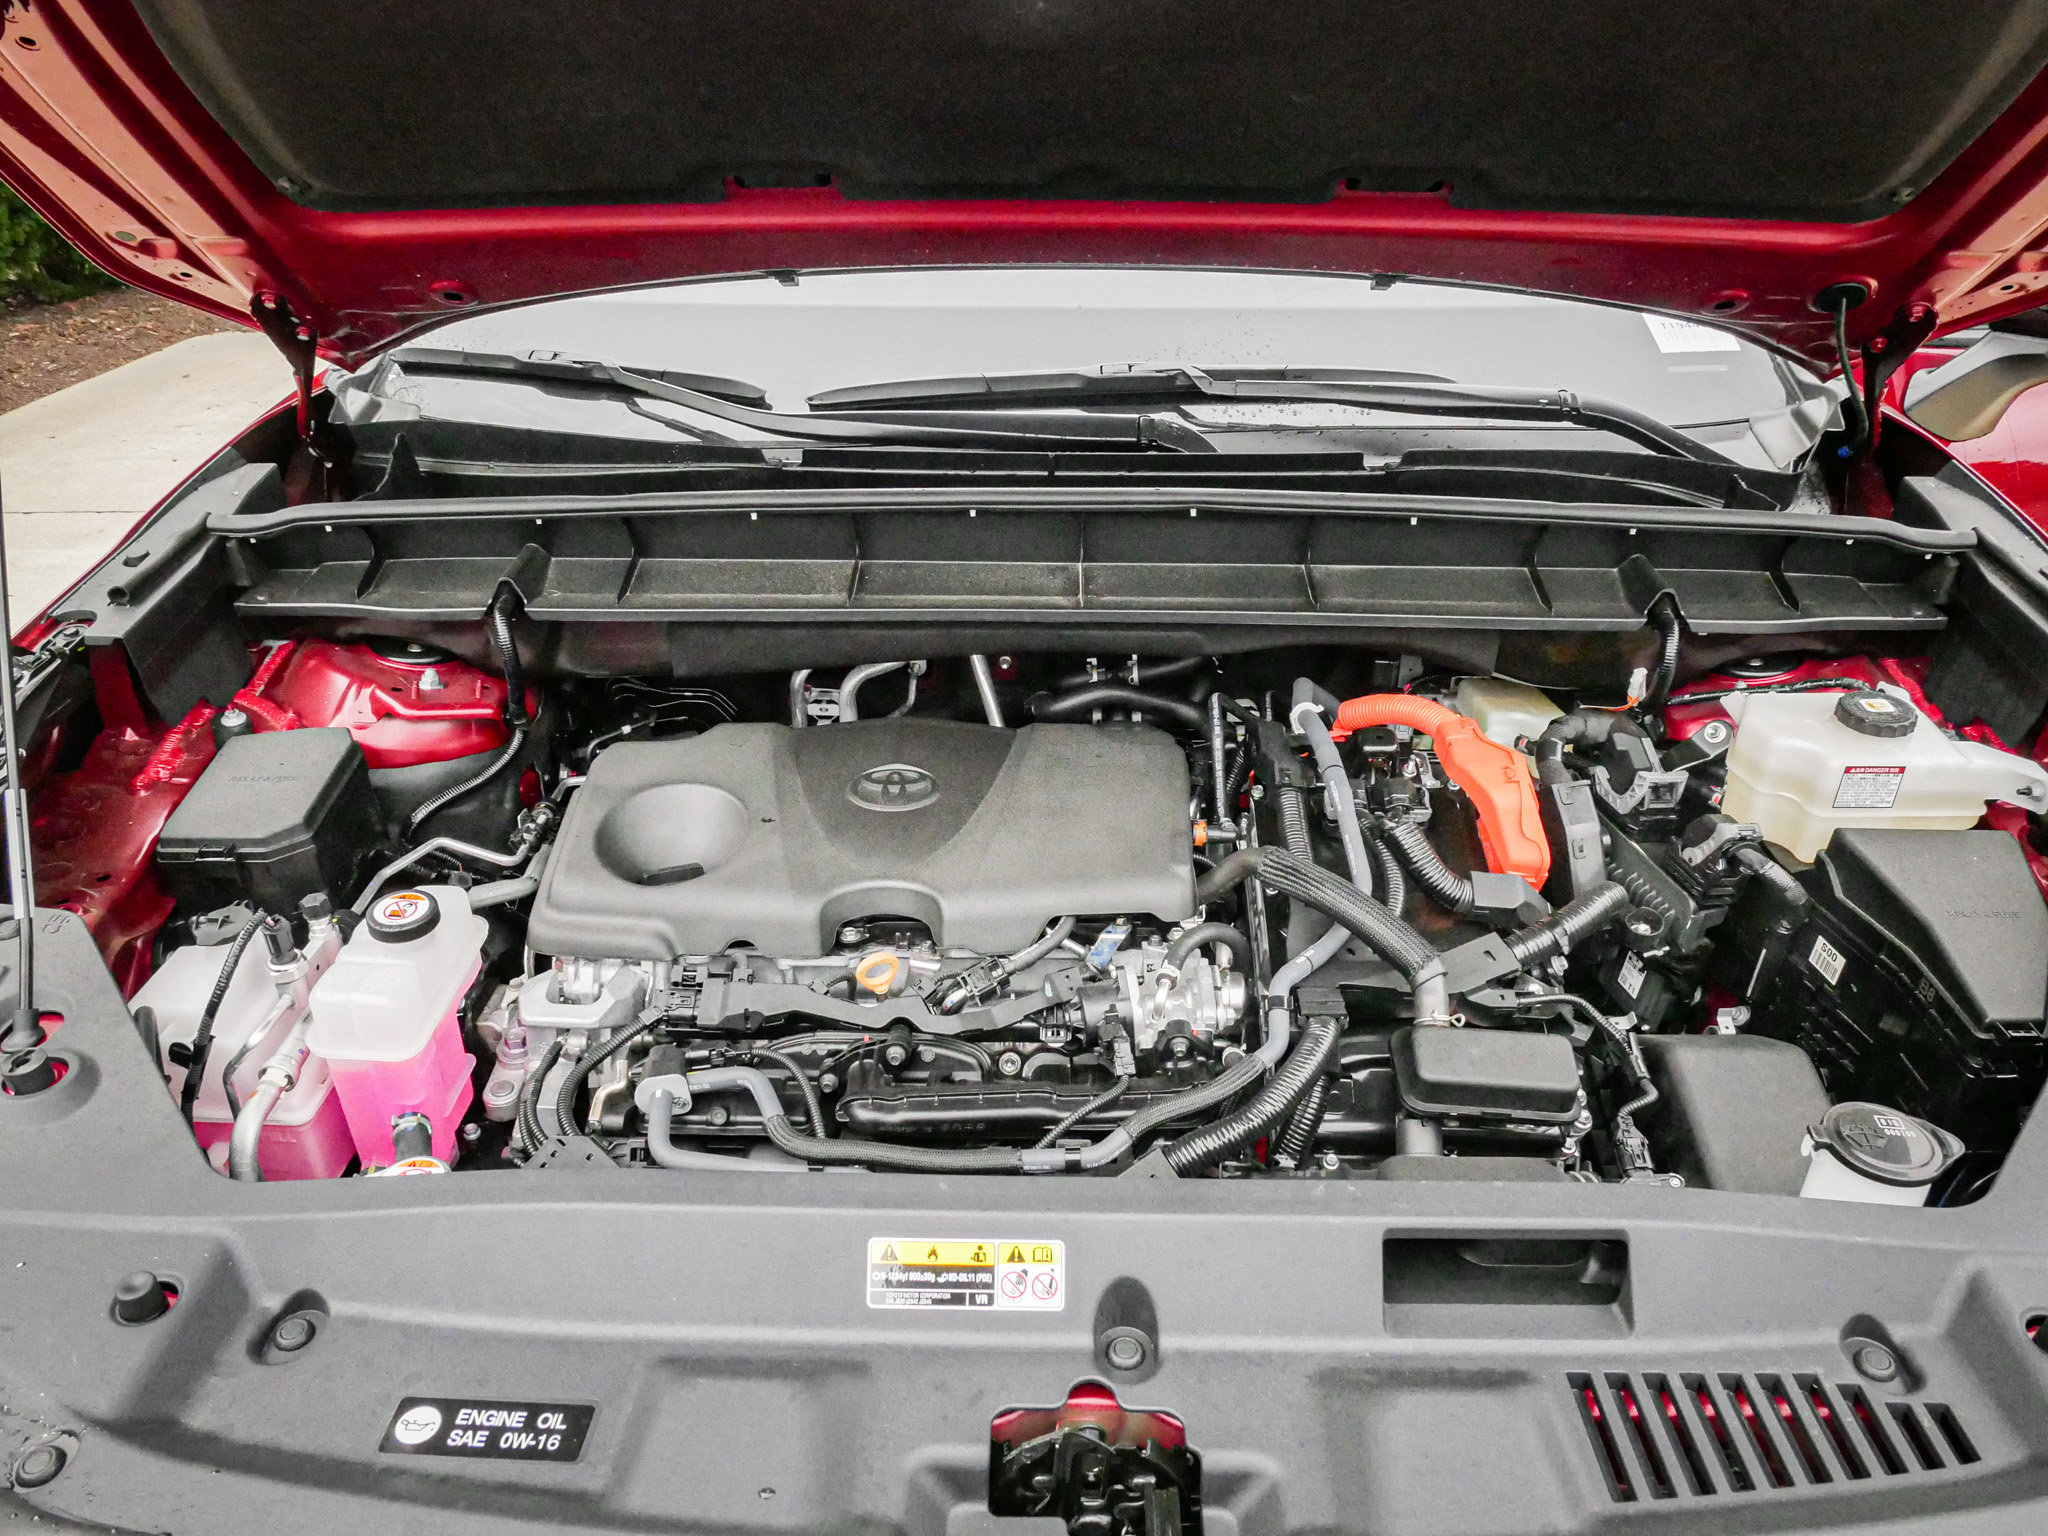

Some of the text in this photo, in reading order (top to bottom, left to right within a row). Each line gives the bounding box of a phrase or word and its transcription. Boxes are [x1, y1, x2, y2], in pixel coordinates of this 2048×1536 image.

[975, 1293, 988, 1305] VR
[455, 1408, 568, 1430] ENGINE OIL
[446, 1430, 562, 1451] SAE 0W-16
